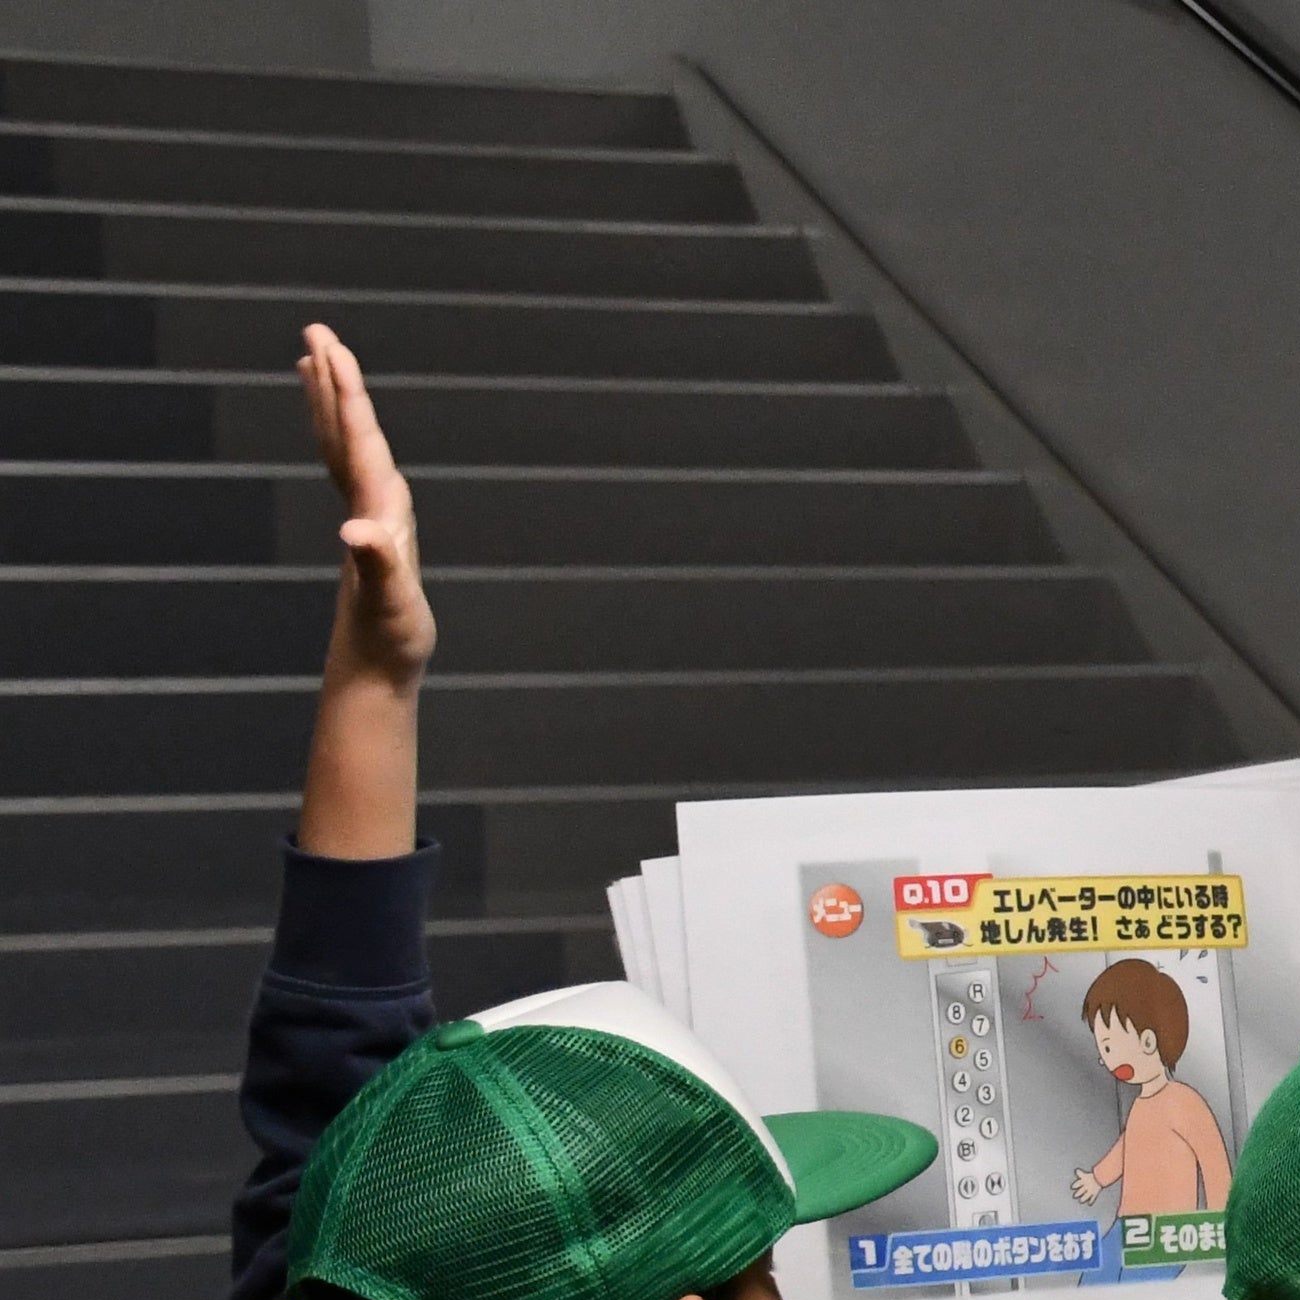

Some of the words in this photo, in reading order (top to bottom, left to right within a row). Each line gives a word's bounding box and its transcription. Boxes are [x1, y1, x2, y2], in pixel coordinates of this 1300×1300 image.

[902, 878, 970, 906] Q.10
[992, 884, 1229, 914] エレベーターの中にいる時
[812, 897, 862, 924] メニュー
[972, 983, 984, 999] R
[952, 1005, 961, 1020] 8
[976, 1018, 985, 1033] 7
[954, 1038, 965, 1054] 6
[979, 1052, 989, 1067] 5
[958, 1073, 967, 1087] 4
[982, 1085, 992, 1101] 3
[960, 1107, 971, 1122] 2
[961, 1141, 977, 1157] B1
[1125, 1217, 1150, 1245] 2
[858, 1239, 877, 1266] 1
